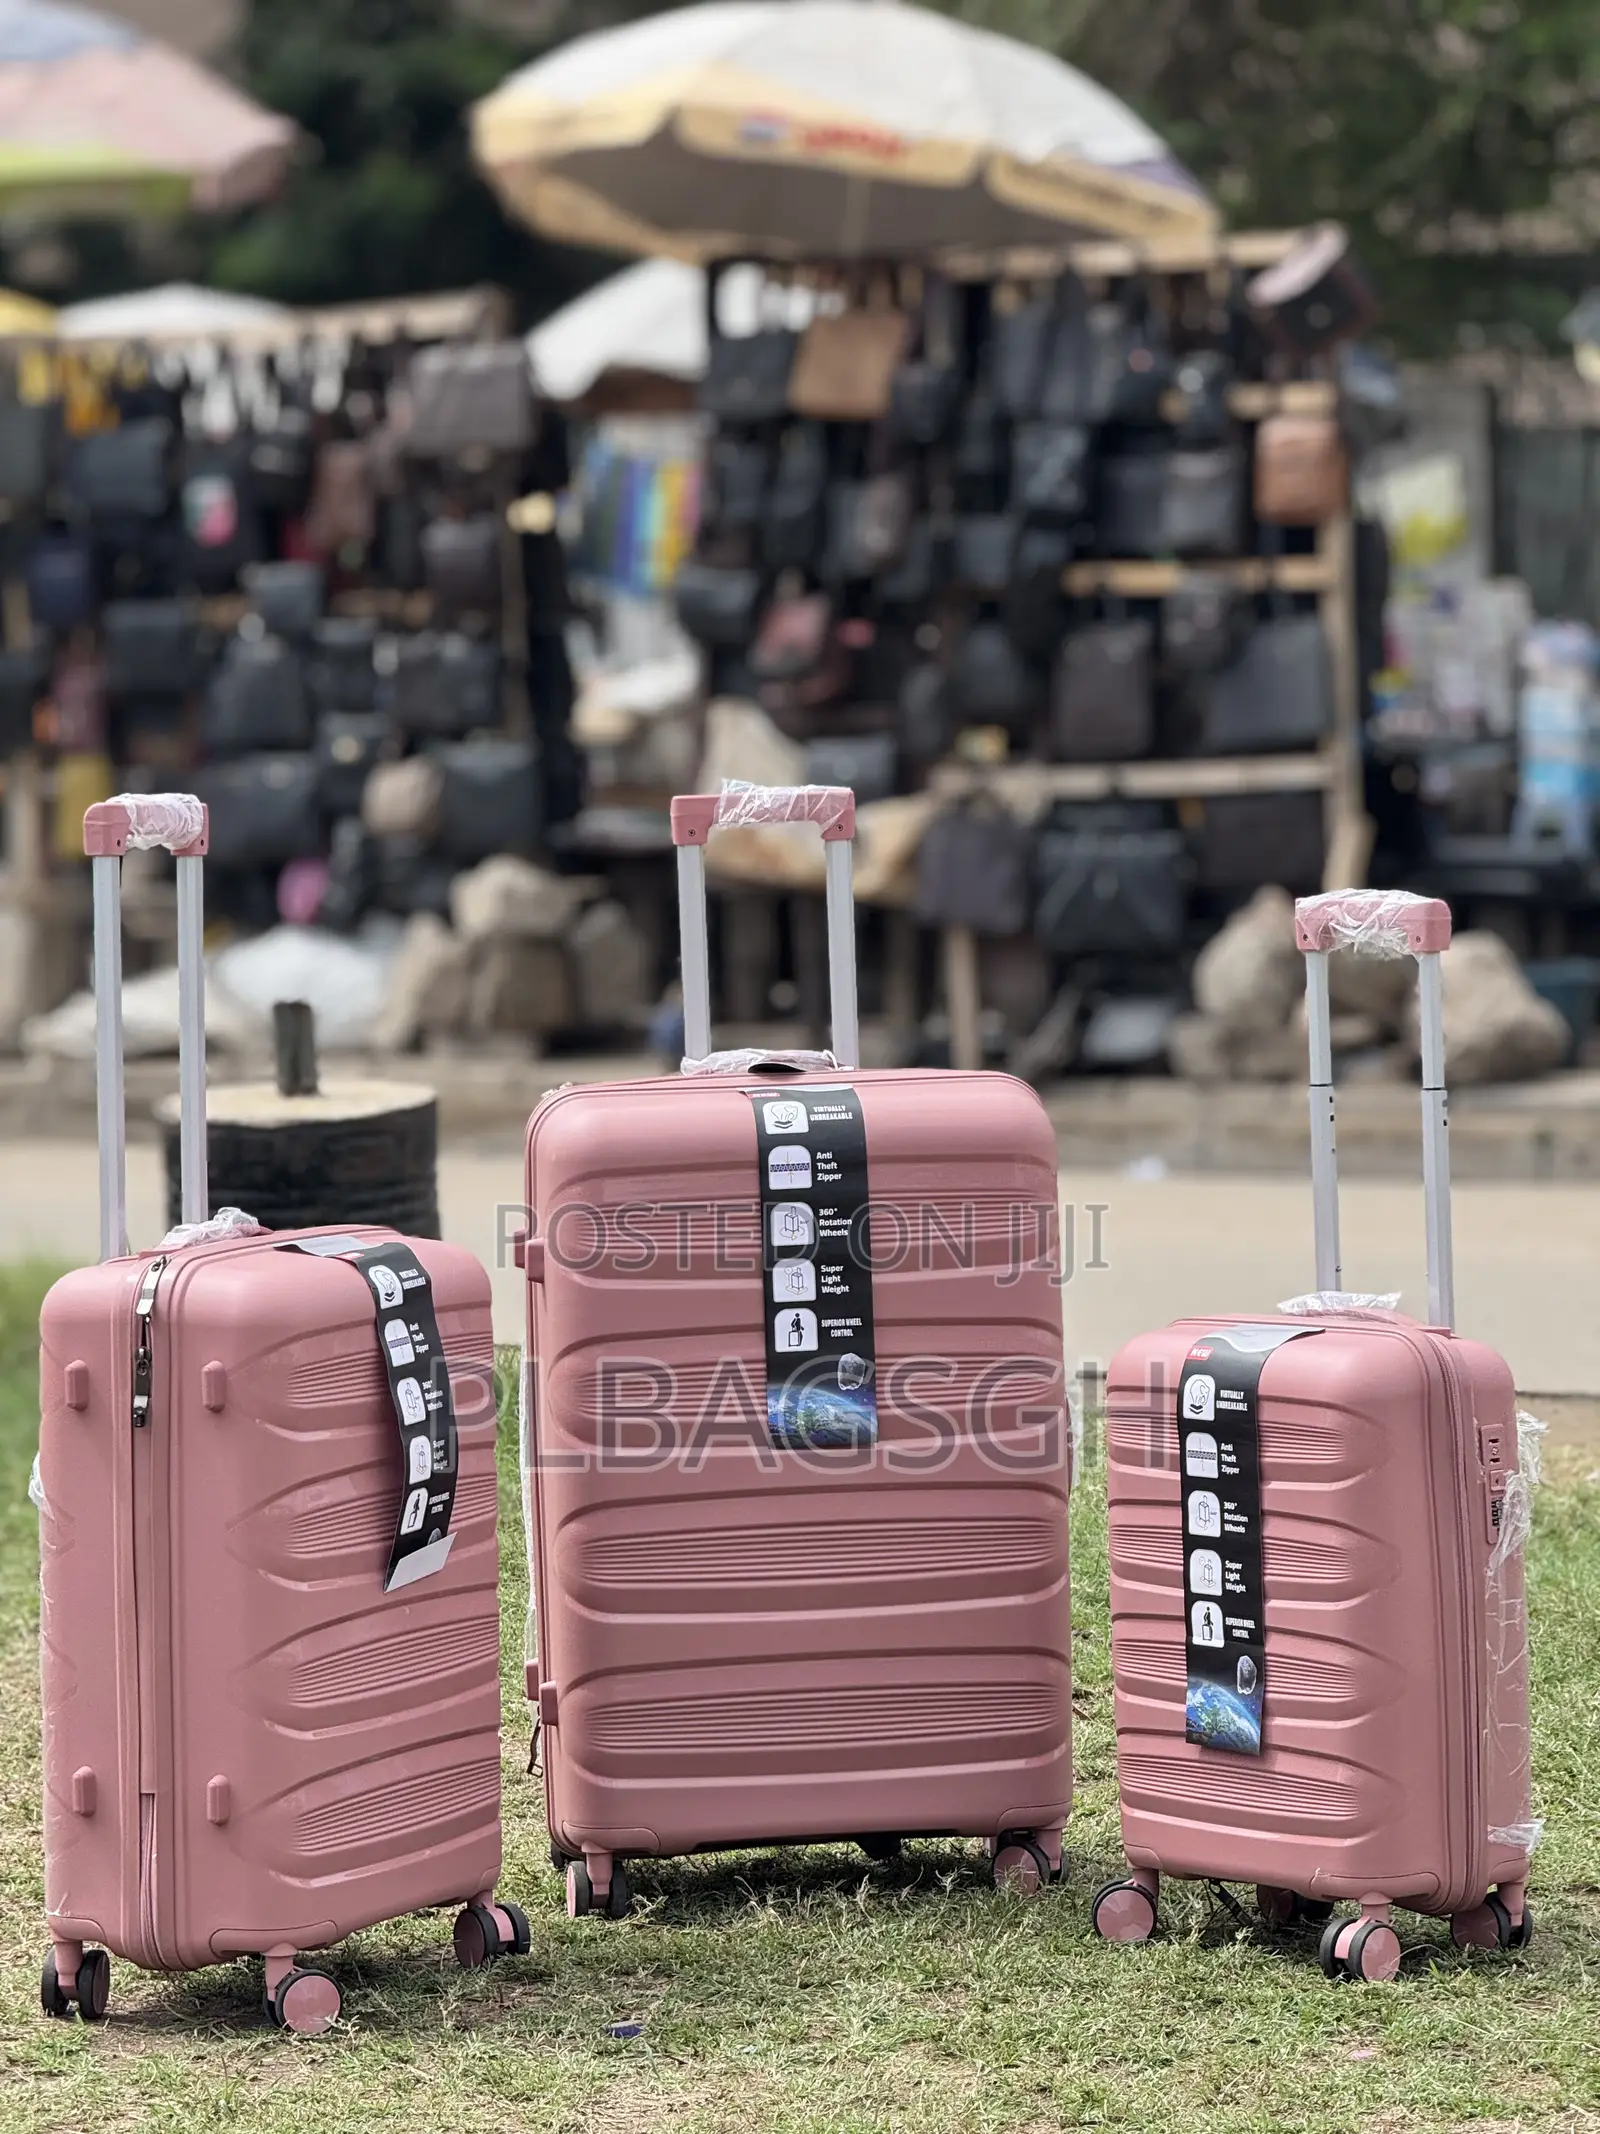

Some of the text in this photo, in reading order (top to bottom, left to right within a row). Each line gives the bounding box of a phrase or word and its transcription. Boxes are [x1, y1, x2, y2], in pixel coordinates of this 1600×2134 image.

[810, 1112, 852, 1121] UNBREAKABLE
[817, 1162, 837, 1170] Theft
[817, 1173, 842, 1182] Zipper
[819, 1208, 837, 1216] 360°
[819, 1218, 852, 1226] Rotation
[821, 1265, 843, 1273] Super
[822, 1275, 840, 1284] Light
[822, 1285, 849, 1294] Weight
[822, 1318, 862, 1327] SUPERIOR WHEEL
[831, 1329, 853, 1337] CONTROL
[1190, 1348, 1212, 1358] NEW
[1221, 1443, 1233, 1451] Anti
[1221, 1454, 1236, 1462] Theft
[1221, 1465, 1239, 1474] Zipper
[1224, 1524, 1245, 1533] Wheels
[1225, 1560, 1242, 1570] Super
[1226, 1571, 1240, 1581] Light
[1225, 1582, 1246, 1593] Weight
